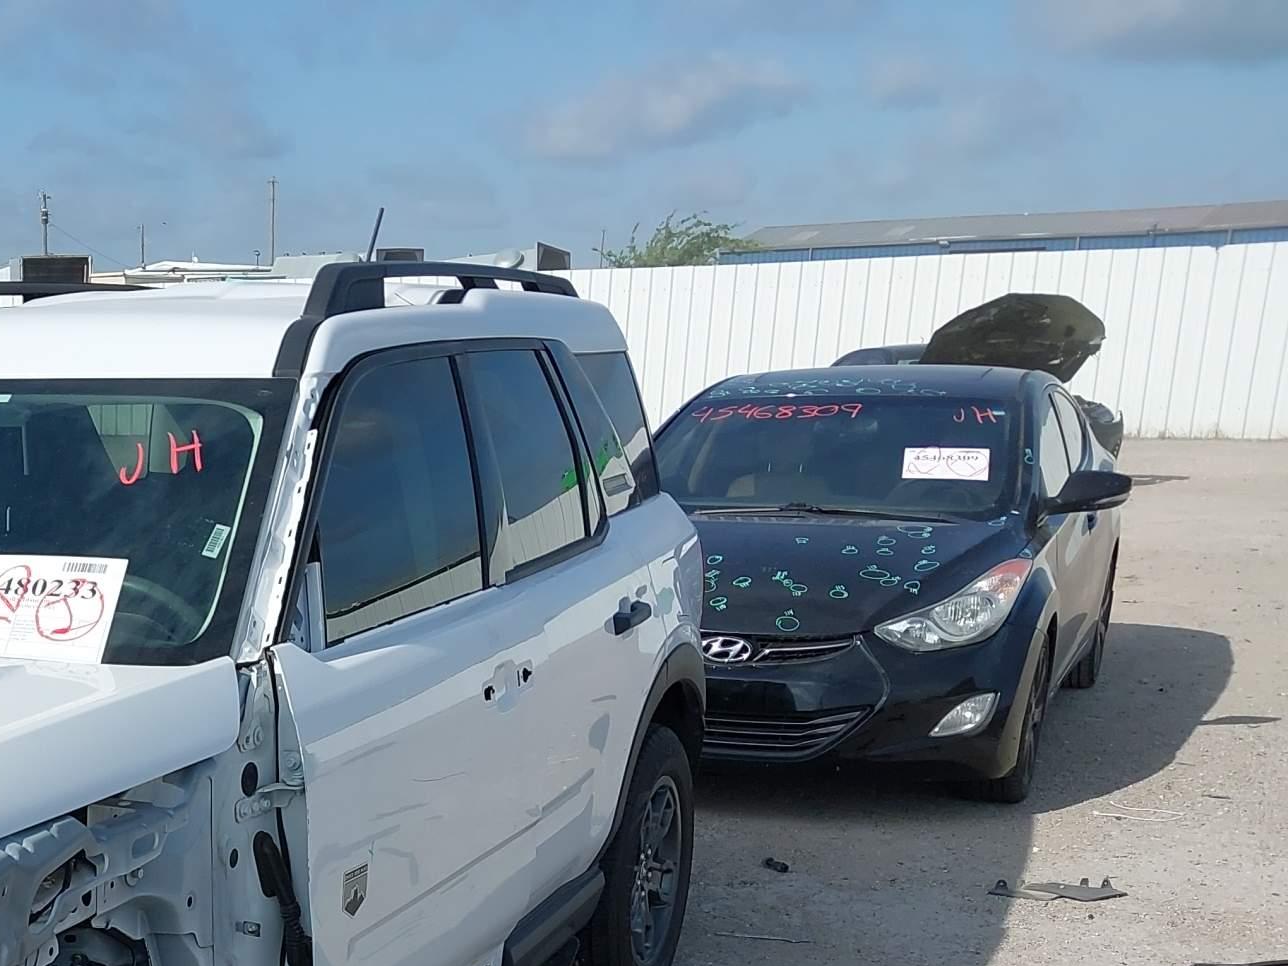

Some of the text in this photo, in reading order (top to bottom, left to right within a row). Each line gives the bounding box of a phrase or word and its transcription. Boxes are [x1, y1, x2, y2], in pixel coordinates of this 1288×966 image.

[691, 403, 863, 422] 45468309
[953, 406, 997, 424] J H
[120, 429, 204, 485] J H
